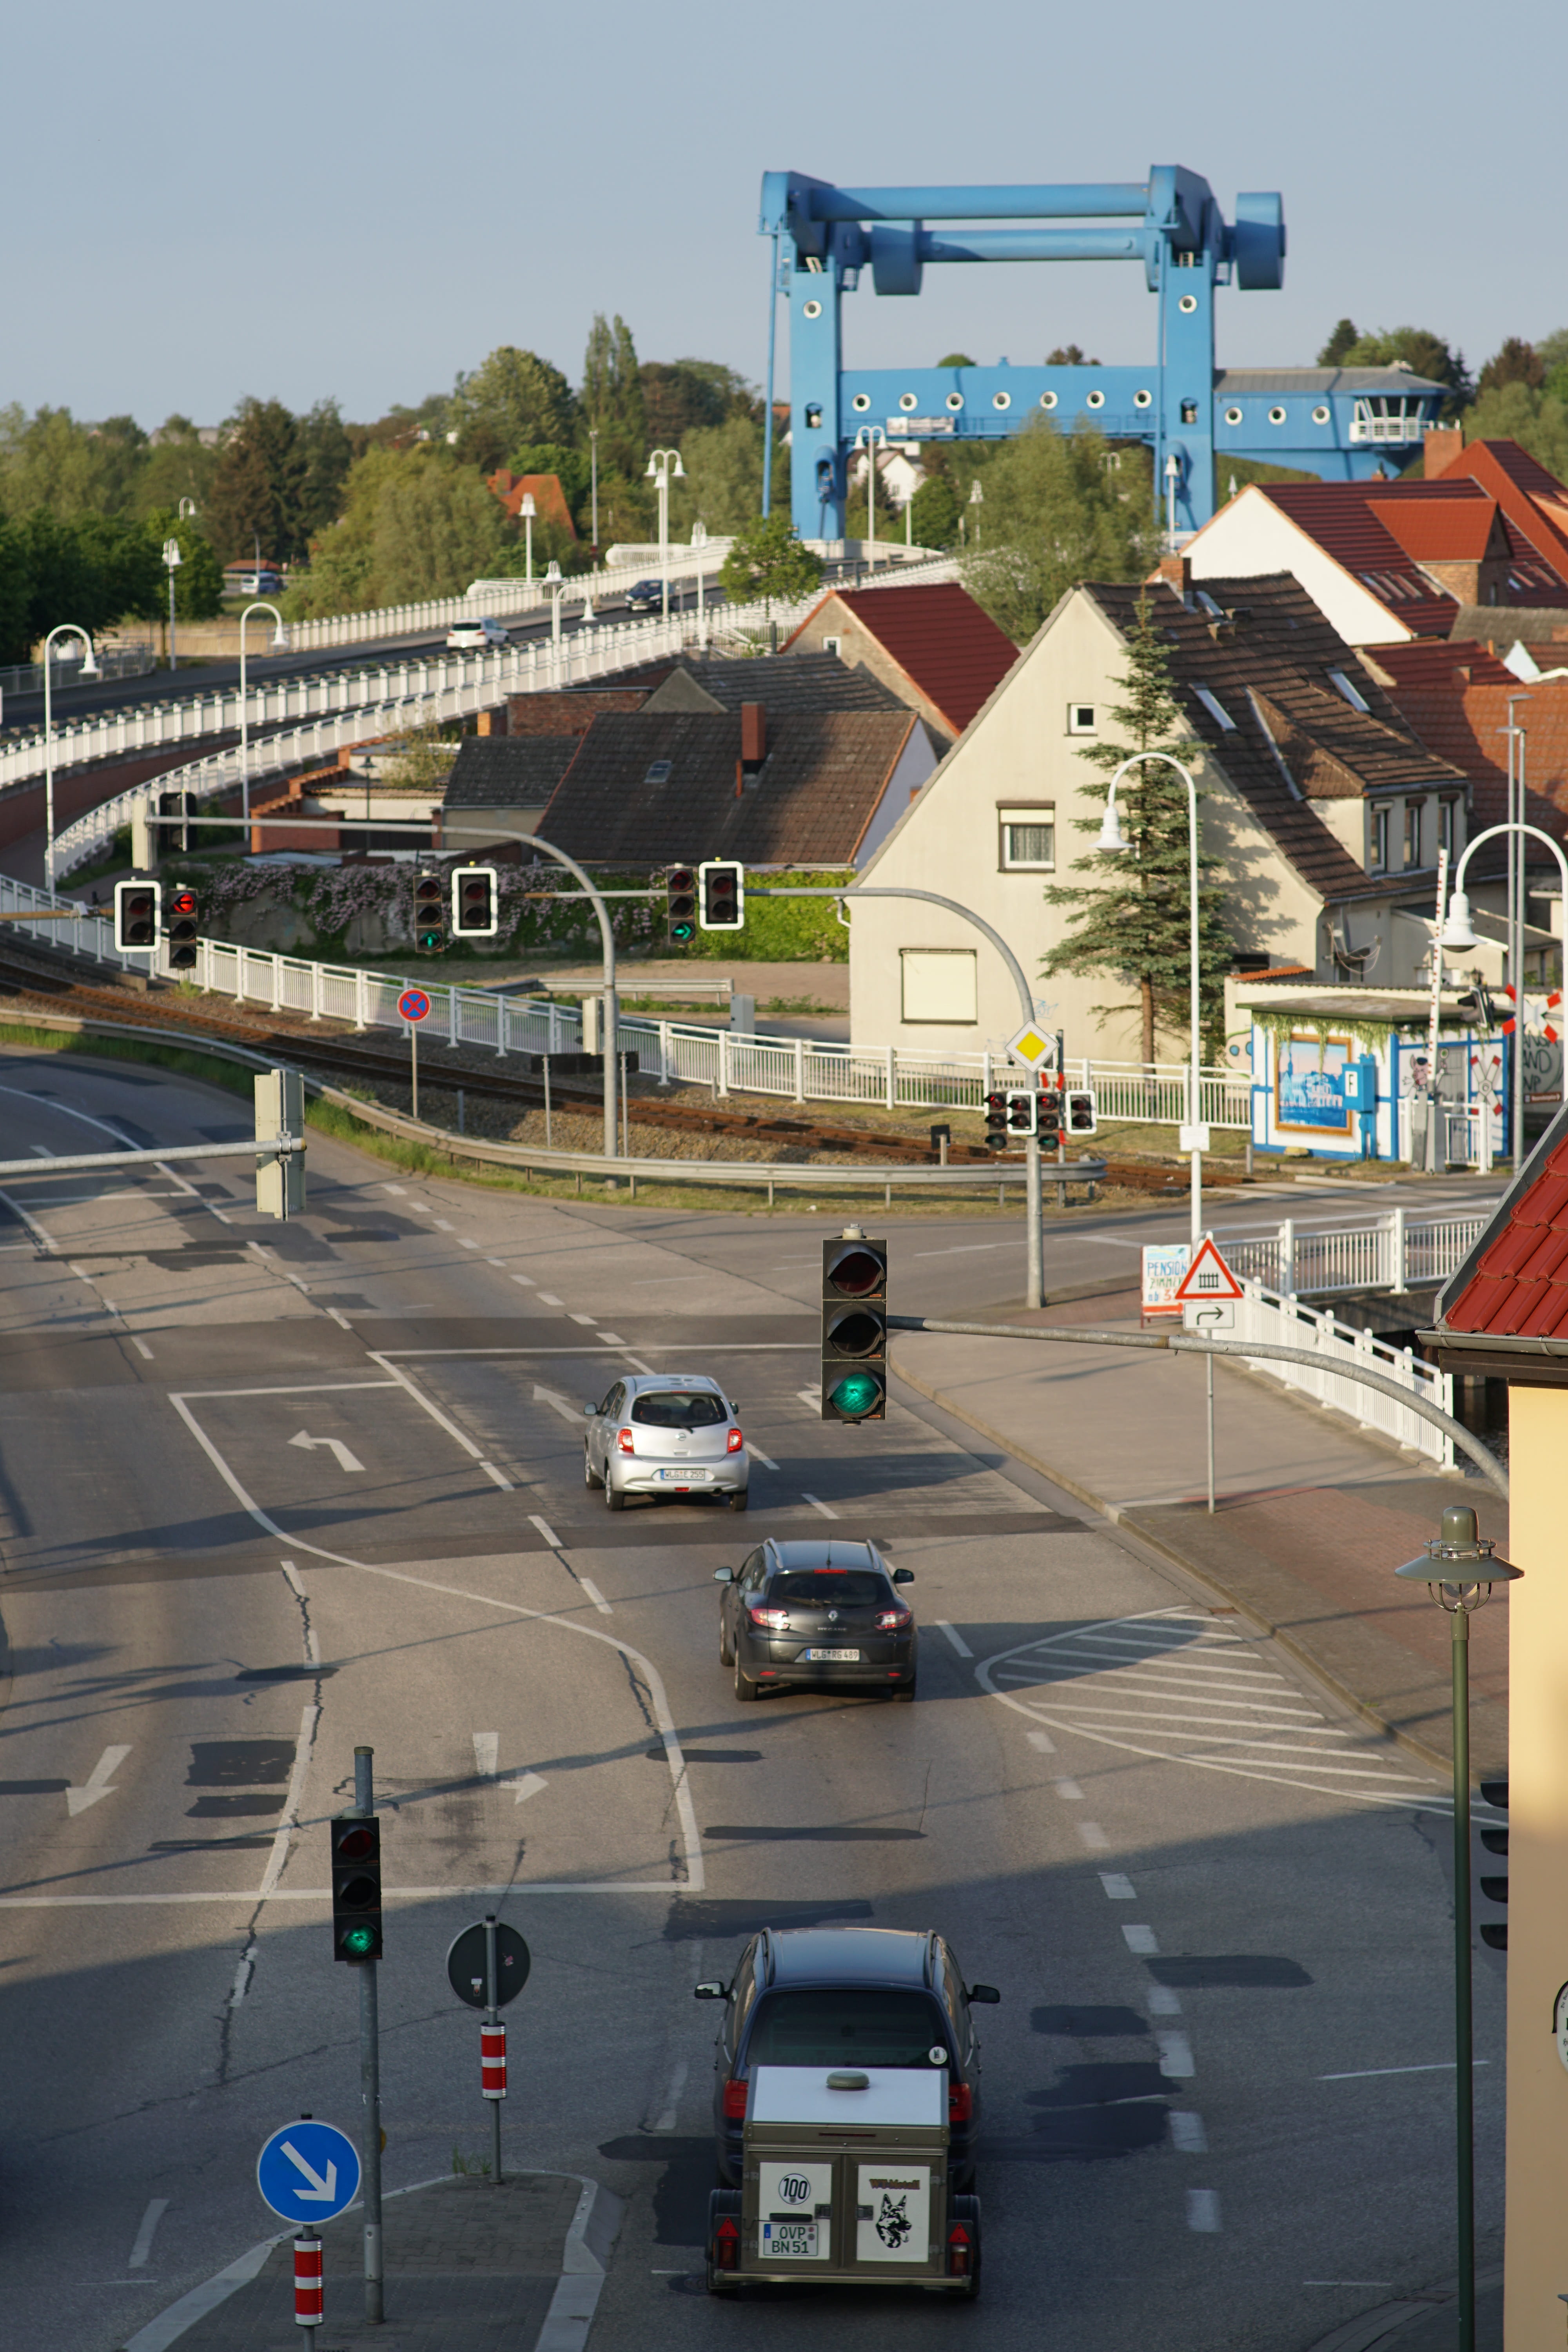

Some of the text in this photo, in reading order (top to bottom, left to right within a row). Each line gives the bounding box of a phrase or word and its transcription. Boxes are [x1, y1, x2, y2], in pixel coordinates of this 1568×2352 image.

[1349, 1074, 1354, 1094] F
[1147, 1261, 1187, 1276] PENSION
[1148, 1291, 1159, 1301] ab
[811, 1650, 858, 1659] WLG RG 489
[783, 2178, 808, 2200] 100
[779, 2226, 806, 2239] OVP
[772, 2241, 809, 2253] BN 51
